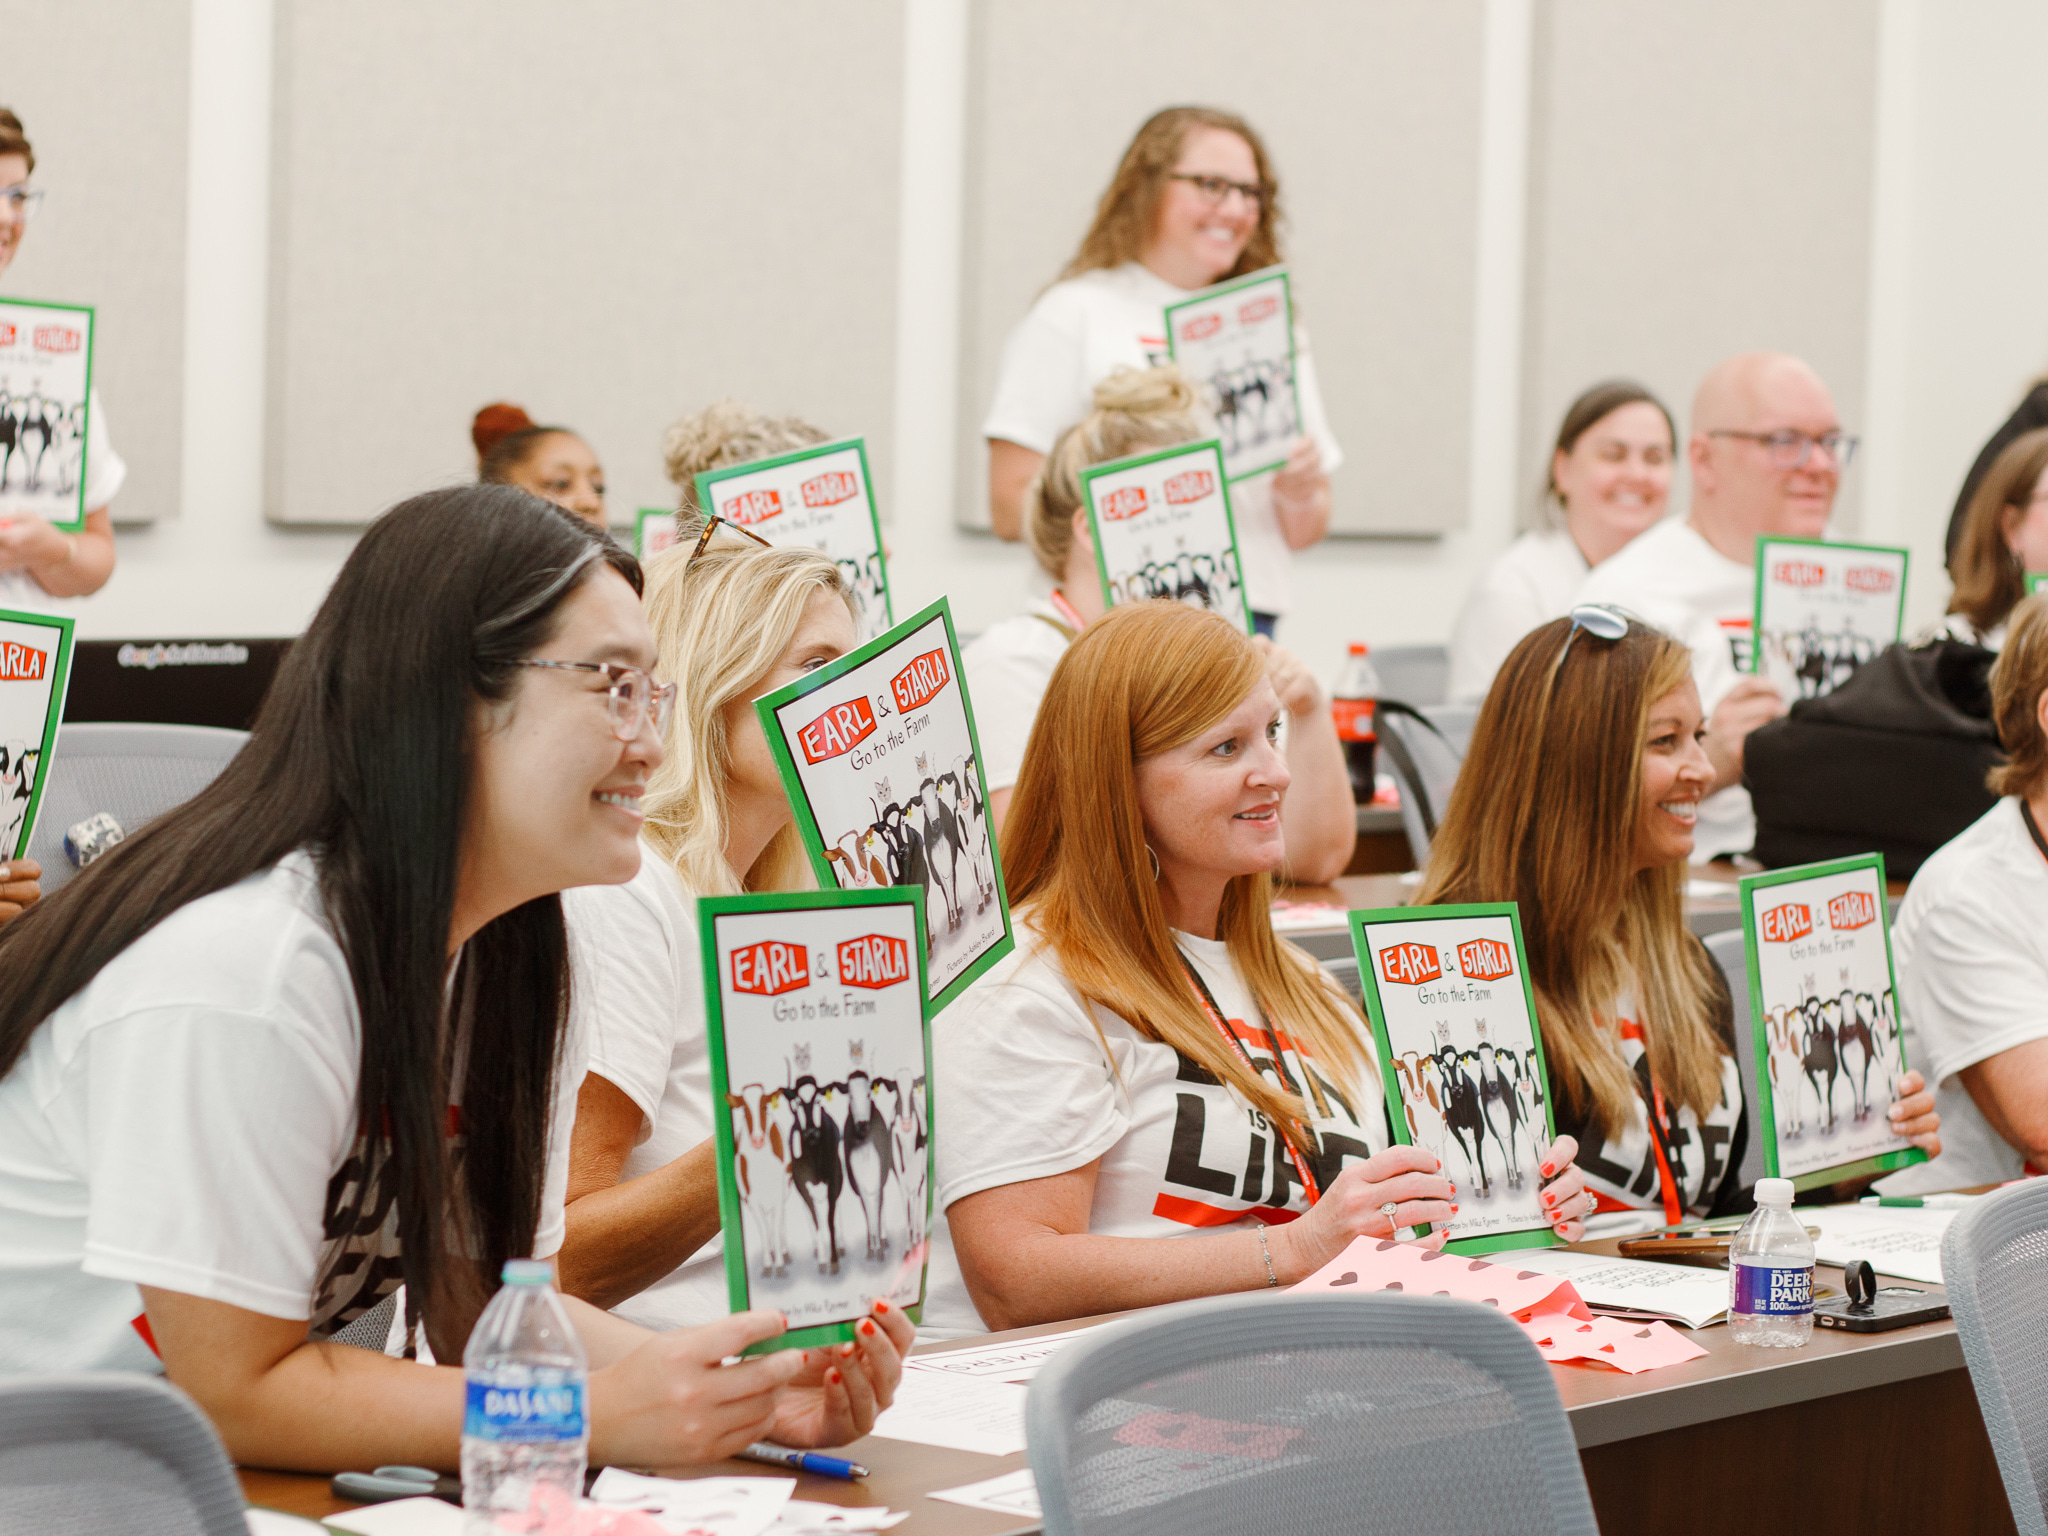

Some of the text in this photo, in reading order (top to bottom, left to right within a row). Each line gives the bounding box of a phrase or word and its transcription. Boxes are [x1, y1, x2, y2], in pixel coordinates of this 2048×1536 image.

[724, 490, 781, 525] EARL
[803, 473, 857, 507] STARLA
[1102, 487, 1147, 520] EARL
[803, 652, 948, 758] EARL & STARLA
[850, 713, 931, 771] Go to the Farm
[1762, 892, 1874, 942] EARL & STARLA
[1383, 940, 1511, 983] EARL & STARLA
[1790, 934, 1855, 961] Go to the Farm
[734, 936, 907, 994] EARL & STARLA
[773, 992, 876, 1022] Go to the Farm
[1417, 983, 1492, 1005] Go to the Farm
[1247, 1108, 1268, 1132] IS
[1770, 1272, 1811, 1288] DEER
[1770, 1287, 1812, 1303] PARK
[485, 1387, 574, 1422] DASANI
